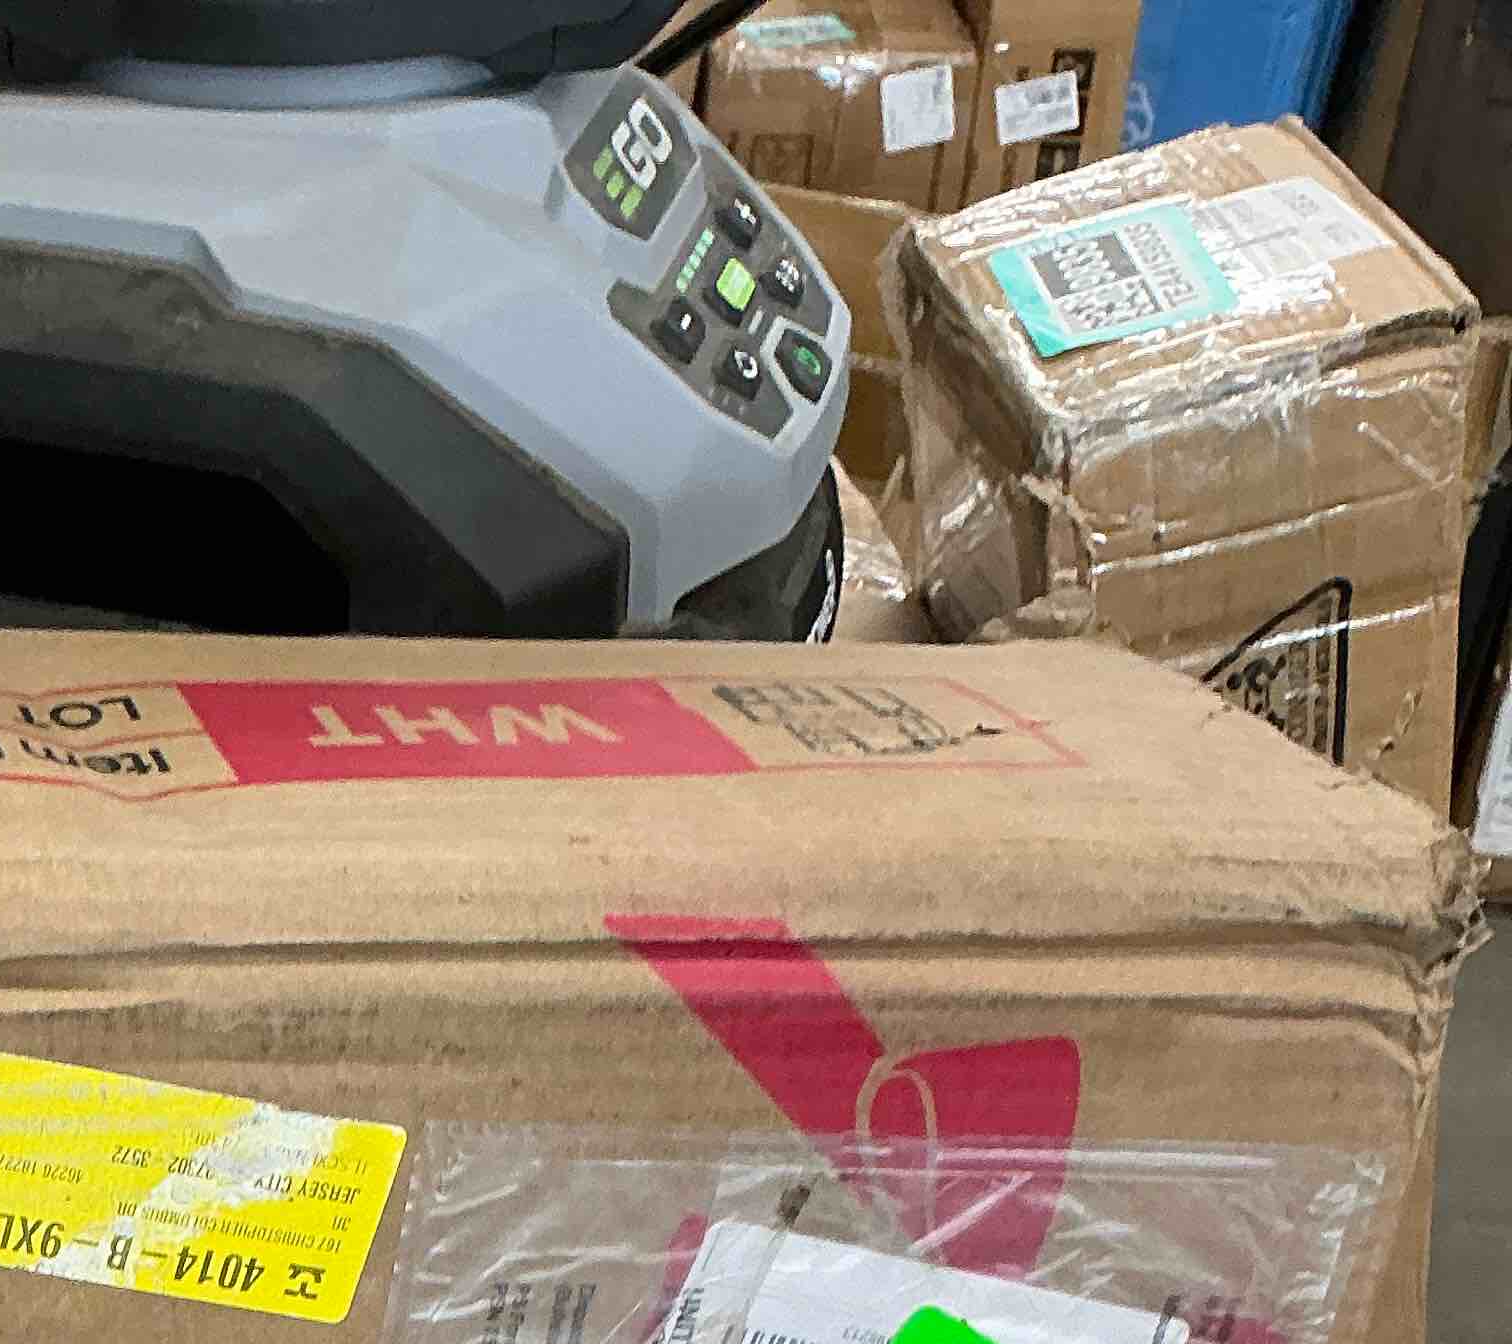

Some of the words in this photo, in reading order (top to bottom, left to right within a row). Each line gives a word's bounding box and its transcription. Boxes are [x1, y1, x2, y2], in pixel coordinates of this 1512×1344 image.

[308, 703, 624, 749] WHT
[17, 738, 172, 775] Item
[297, 1181, 361, 1205] JERSEY
